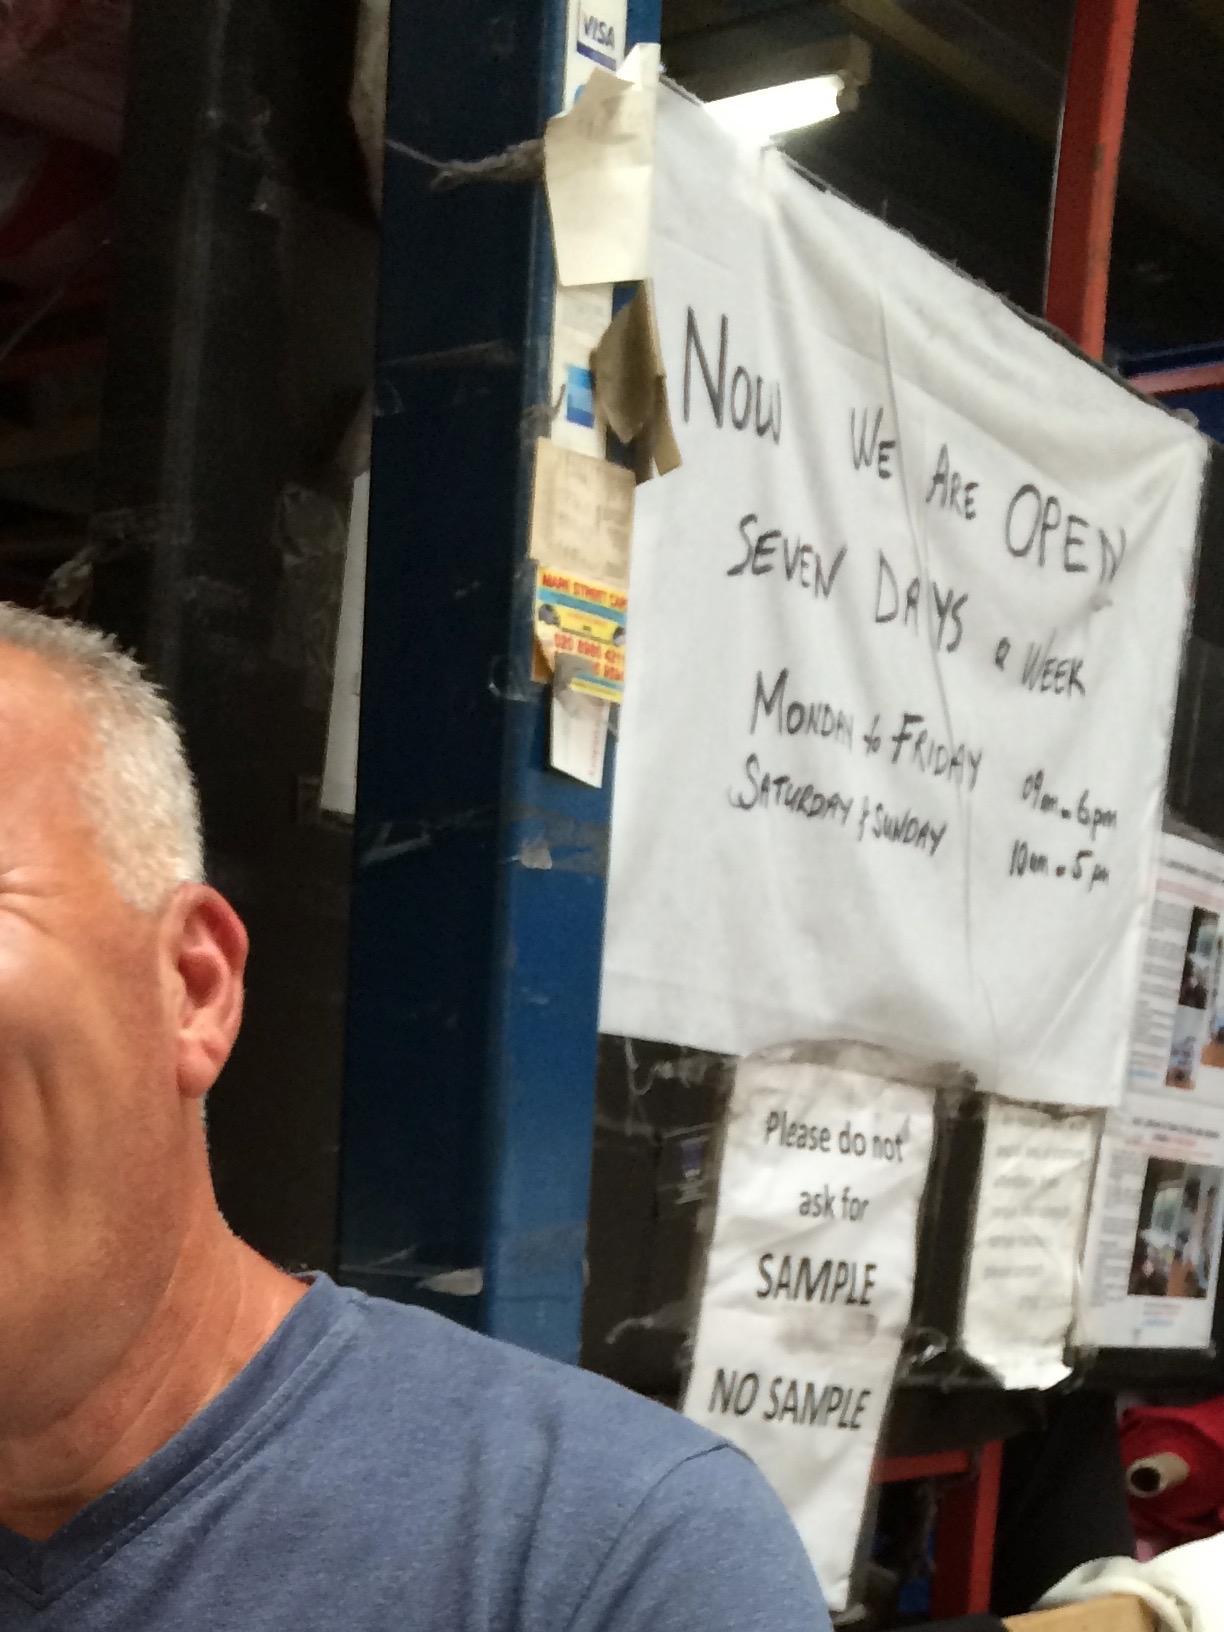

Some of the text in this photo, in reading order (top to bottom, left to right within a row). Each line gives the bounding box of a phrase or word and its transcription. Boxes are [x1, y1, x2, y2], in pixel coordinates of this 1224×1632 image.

[584, 16, 615, 49] VISA
[682, 306, 1127, 582] NOW WE ARE OPEN
[727, 513, 848, 599] SEVEN
[874, 547, 969, 653] DAYS
[1021, 628, 1086, 697] WEEK
[749, 667, 854, 750] MONDAY
[891, 711, 983, 791] FRIDAY
[729, 753, 854, 826] SATURDAY
[872, 802, 948, 857] SUNDAY
[764, 1110, 907, 1164] Please do not
[798, 1185, 870, 1223] ask for
[756, 1253, 877, 1305] SAMPLE
[708, 1368, 871, 1430] NO SAMPLE
